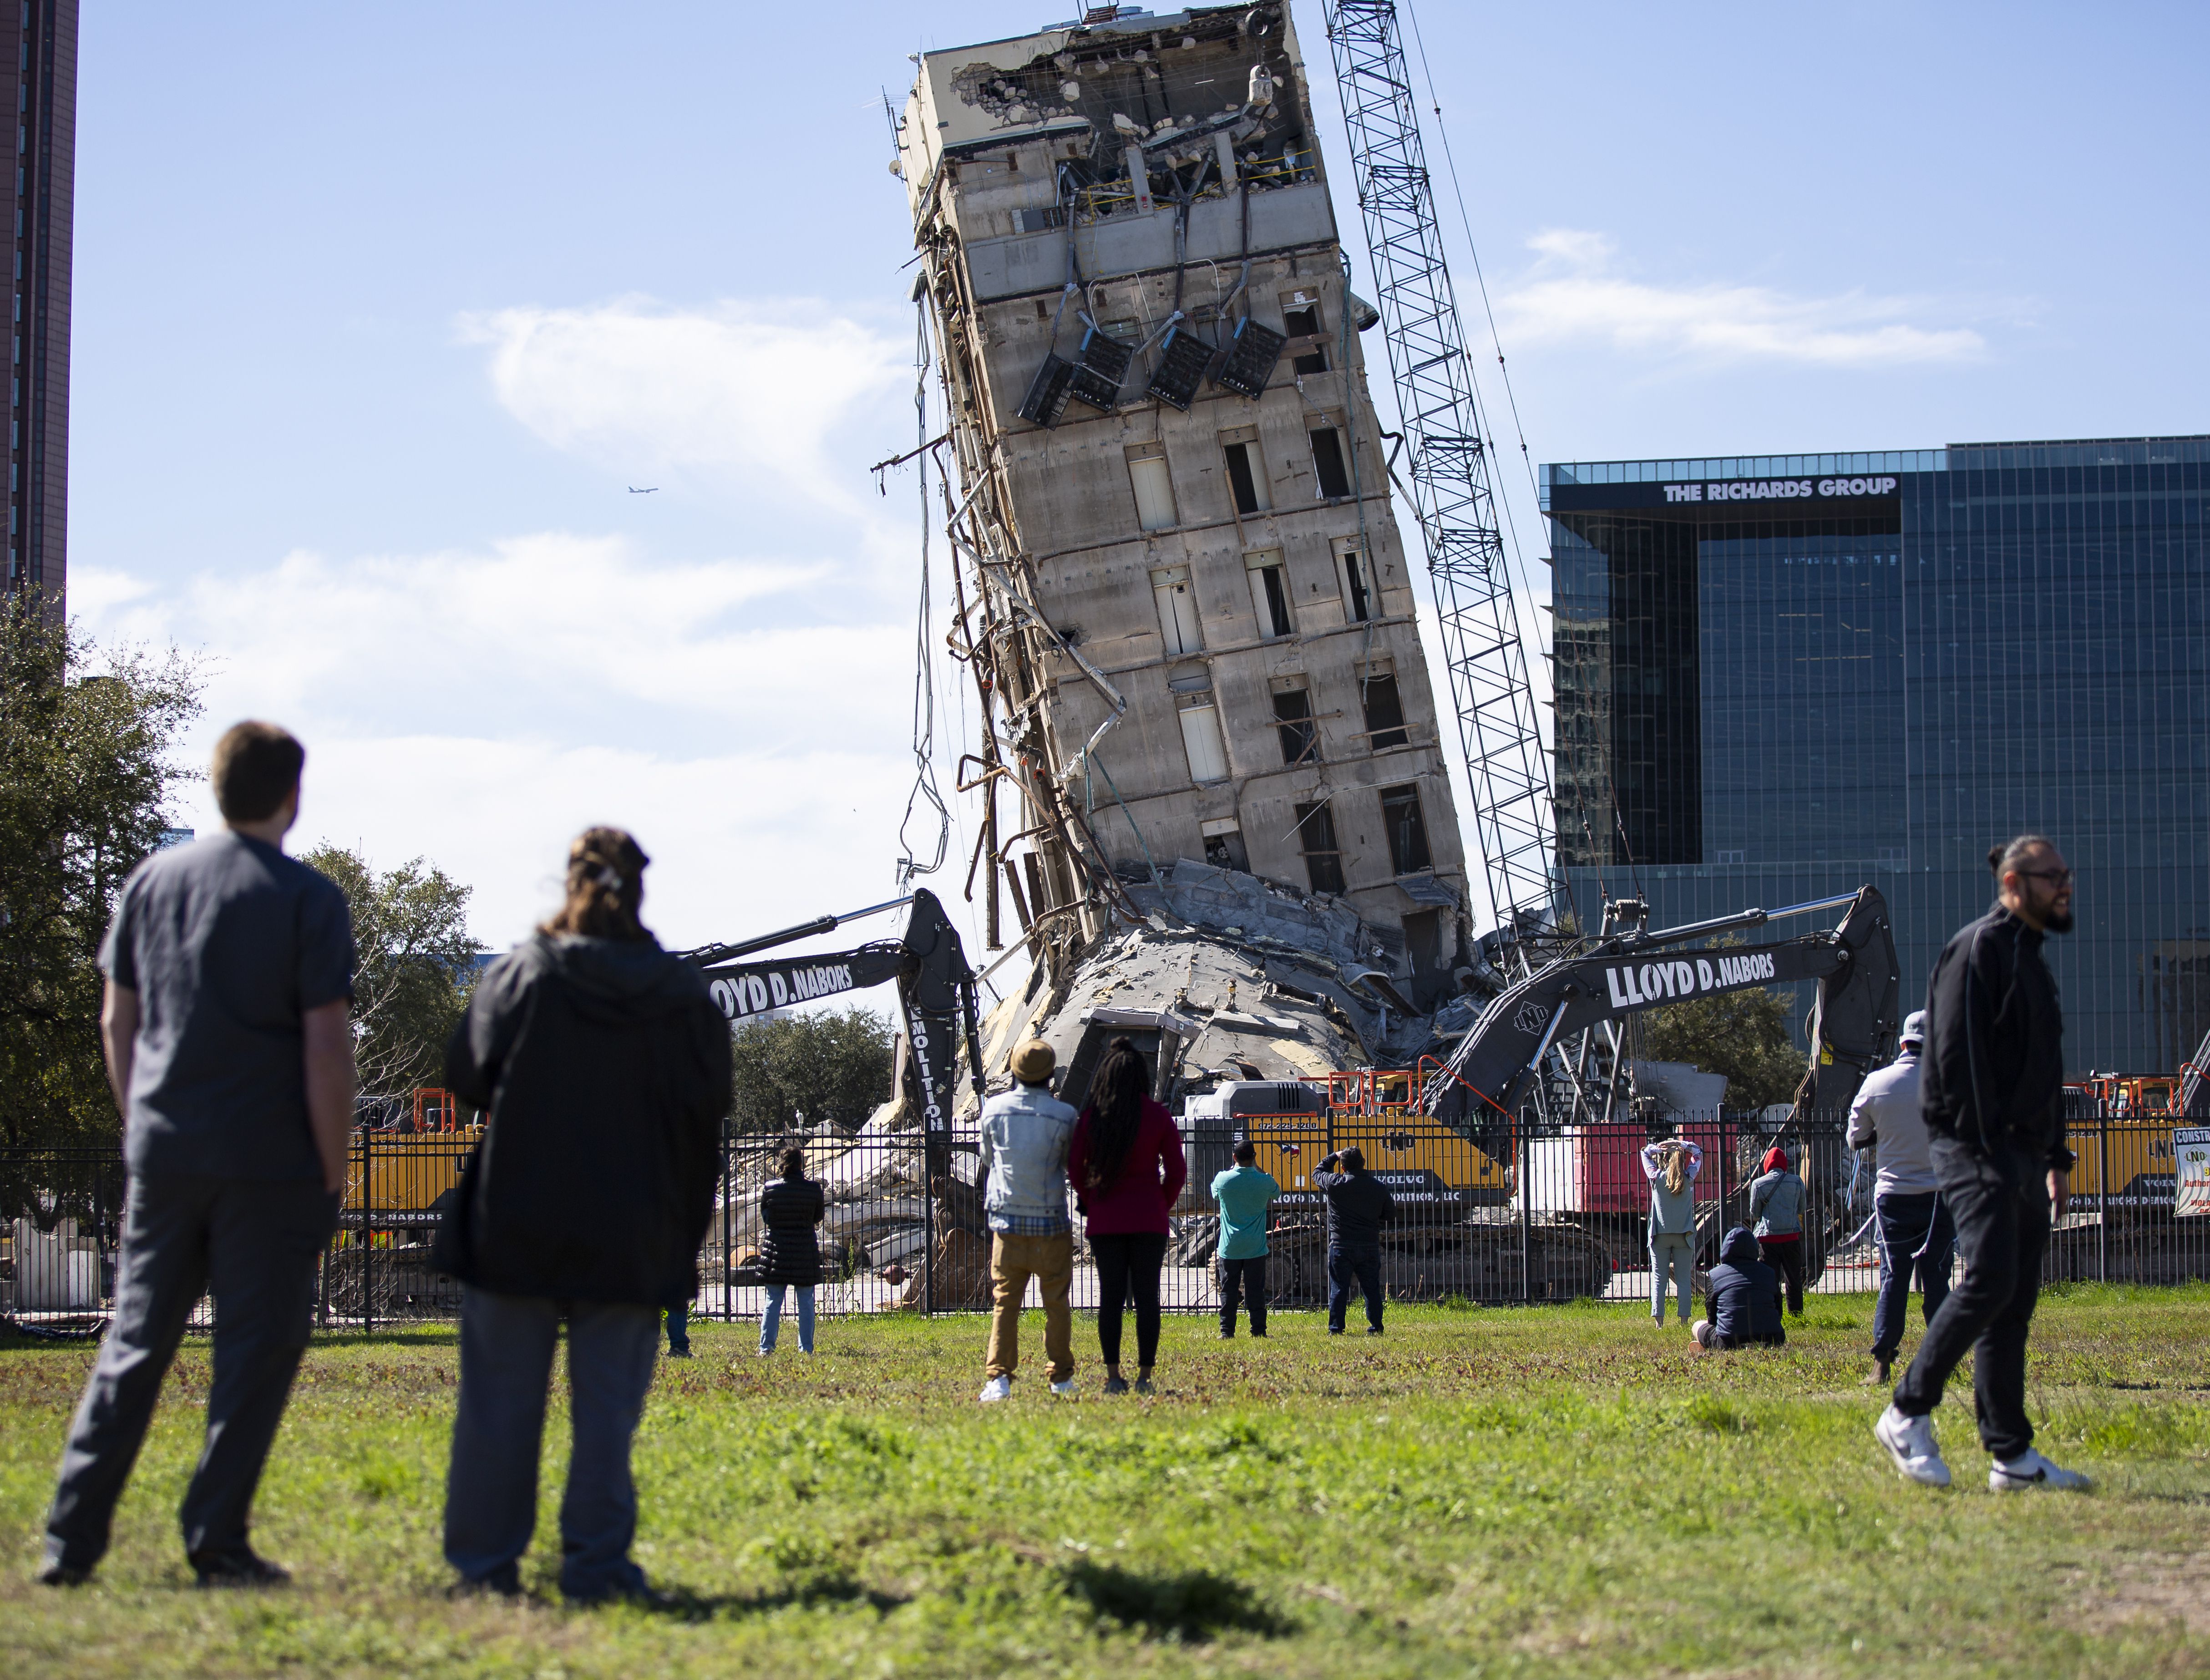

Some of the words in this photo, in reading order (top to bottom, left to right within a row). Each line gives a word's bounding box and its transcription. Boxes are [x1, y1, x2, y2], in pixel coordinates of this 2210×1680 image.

[1663, 485, 1702, 502] THE
[1708, 480, 1813, 500] RICHARDS
[1818, 477, 1896, 496] GROUP
[1606, 961, 1694, 1008] LLOYD
[1514, 1005, 1548, 1031] LND
[2185, 1151, 2205, 1162] LND
[1374, 1176, 1425, 1184] VOLVO
[1444, 1192, 1460, 1200] LLC
